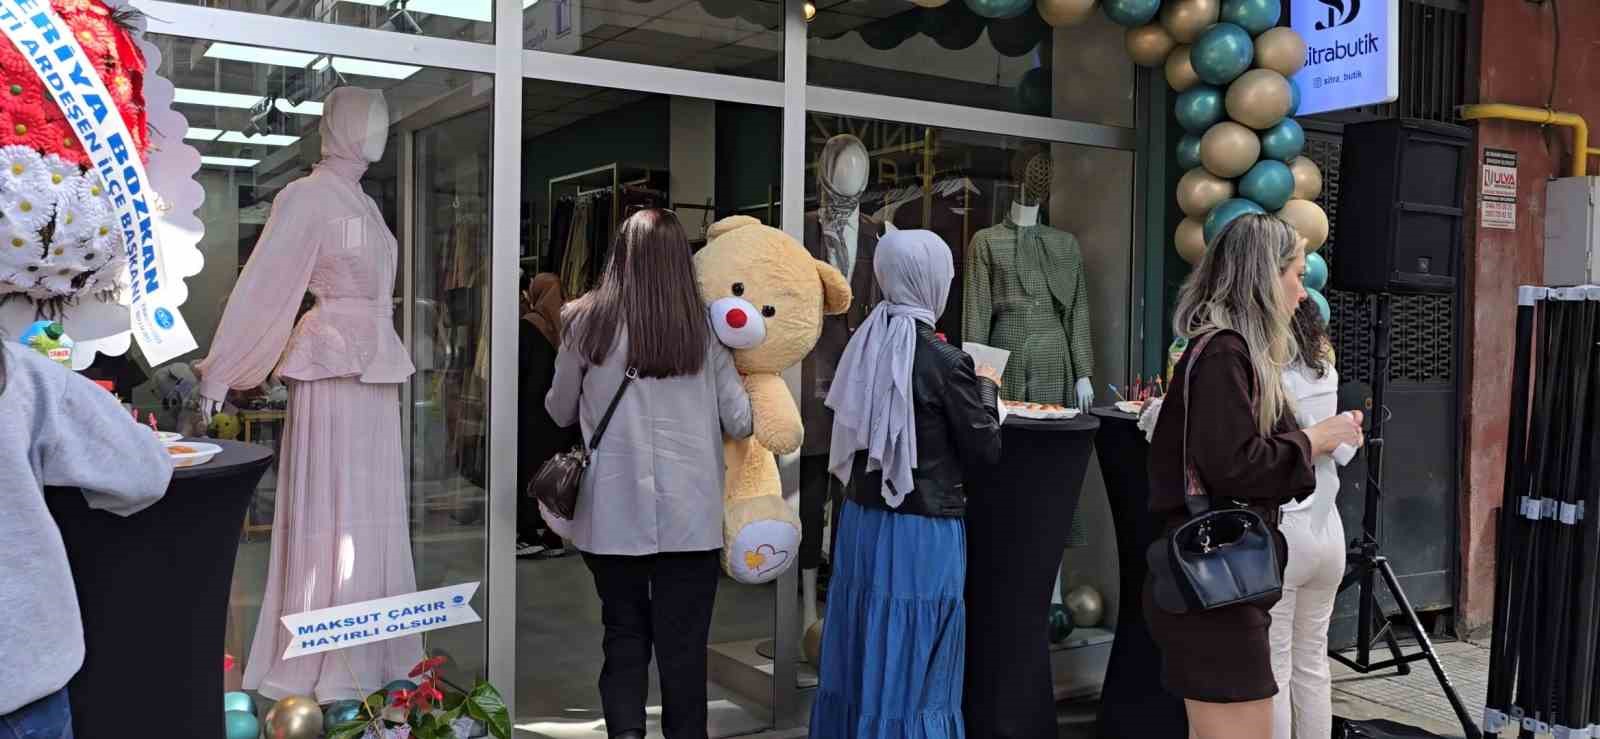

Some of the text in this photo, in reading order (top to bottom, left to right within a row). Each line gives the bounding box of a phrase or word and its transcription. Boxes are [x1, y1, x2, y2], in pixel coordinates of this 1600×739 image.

[20, 39, 102, 153] ARDEŞEN
[97, 156, 127, 209] İLÇE
[106, 132, 160, 295] BOZKAN
[298, 600, 446, 636] MAKSUT ÇAKIR
[301, 614, 448, 649] HAYIRLI OLSUN
